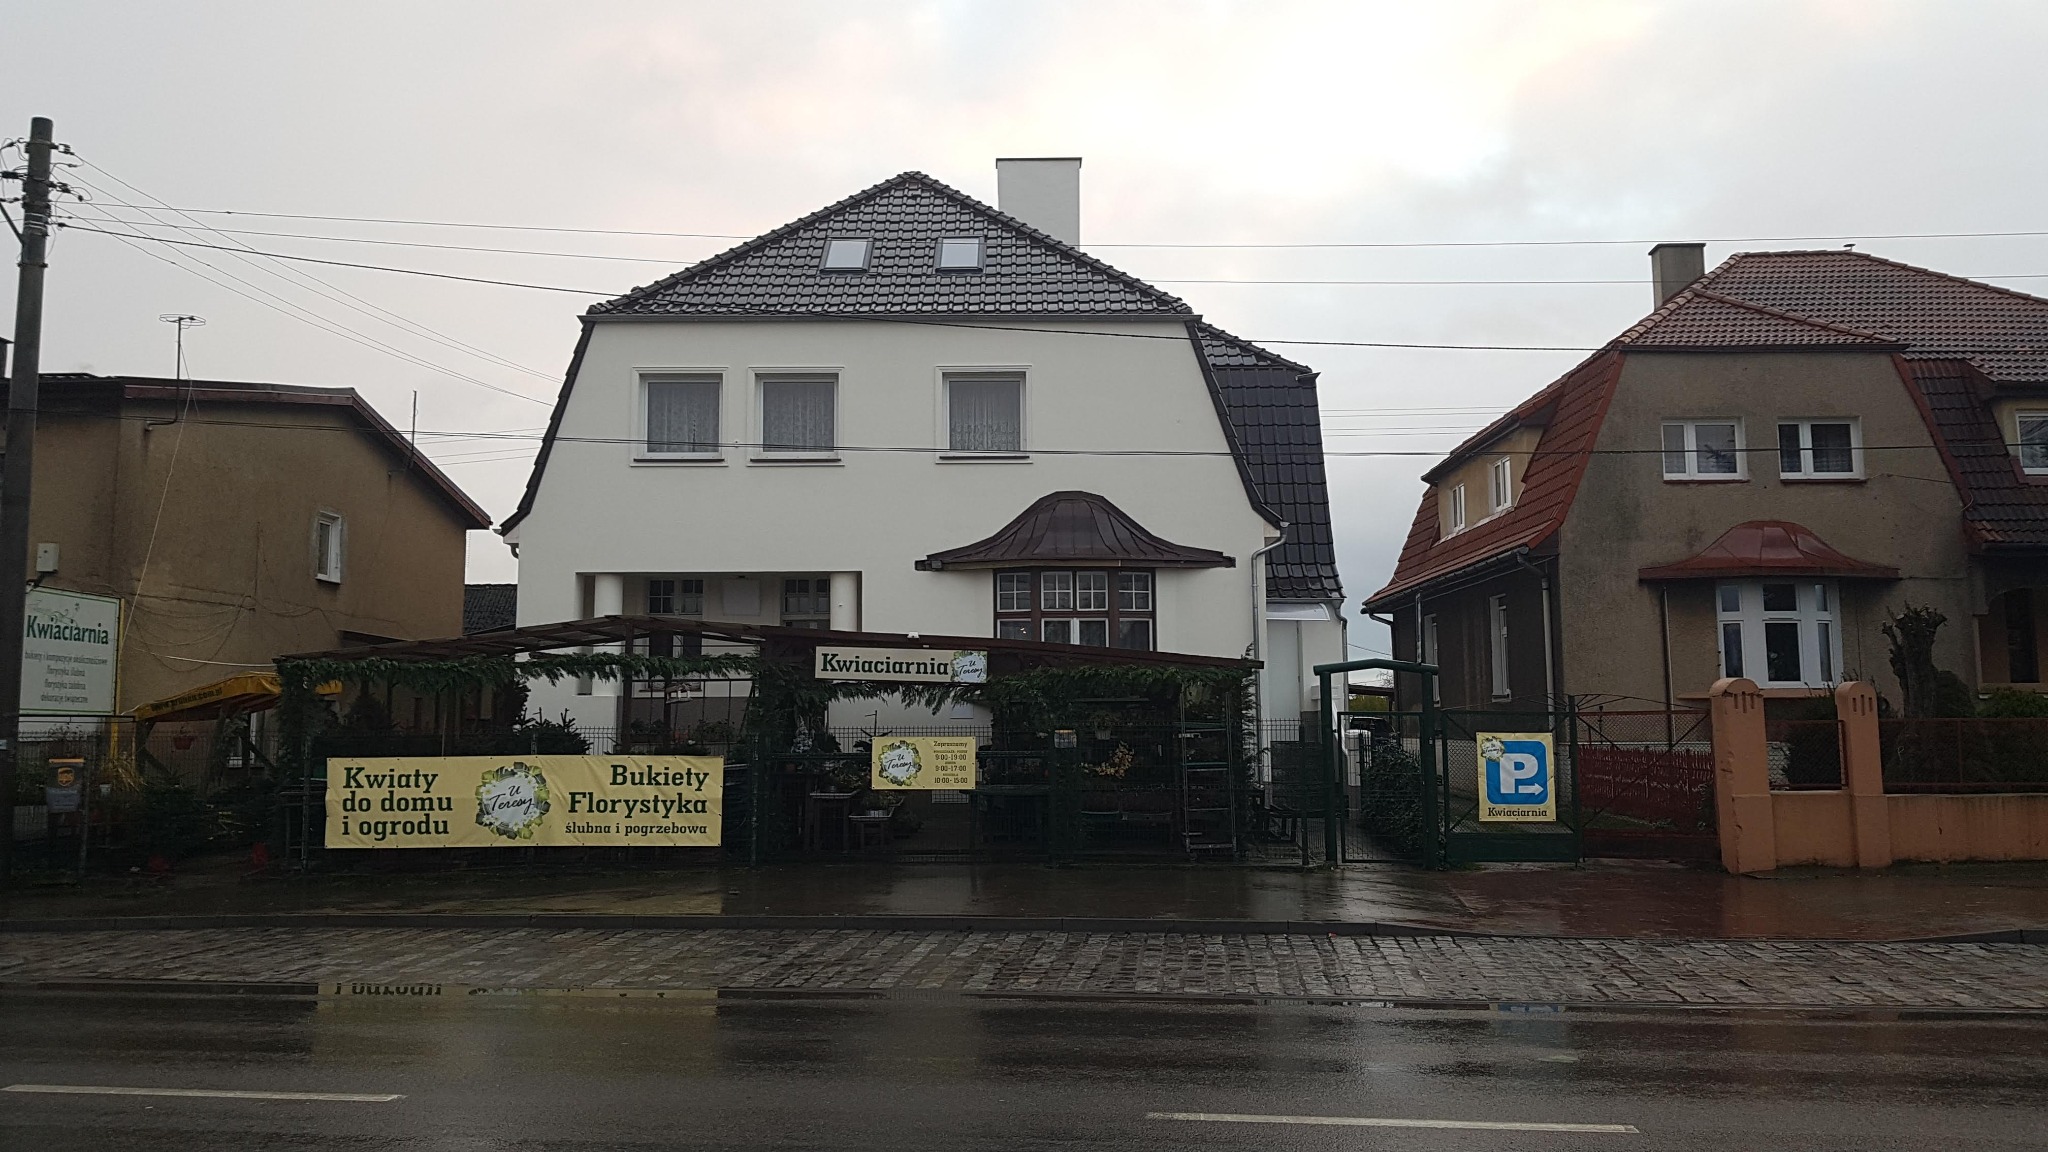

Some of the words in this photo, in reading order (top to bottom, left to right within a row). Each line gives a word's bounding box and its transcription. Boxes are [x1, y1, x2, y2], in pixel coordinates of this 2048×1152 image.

[26, 614, 109, 645] Kwiaciarnia
[821, 652, 949, 676] Kwiaciarnia
[342, 766, 439, 794] Kwiaty
[609, 764, 710, 792] Bukiety
[1500, 753, 1539, 794] P
[342, 790, 372, 812] do
[380, 790, 453, 812] domu
[489, 793, 535, 815] Teresy
[567, 791, 708, 819] Florystyka
[1487, 807, 1548, 817] Kwiaciarnia
[341, 815, 350, 836] i
[359, 813, 449, 841] ogrodu
[565, 821, 611, 834] ślubna
[615, 822, 620, 834] i
[624, 821, 708, 837] pogrzebowa
